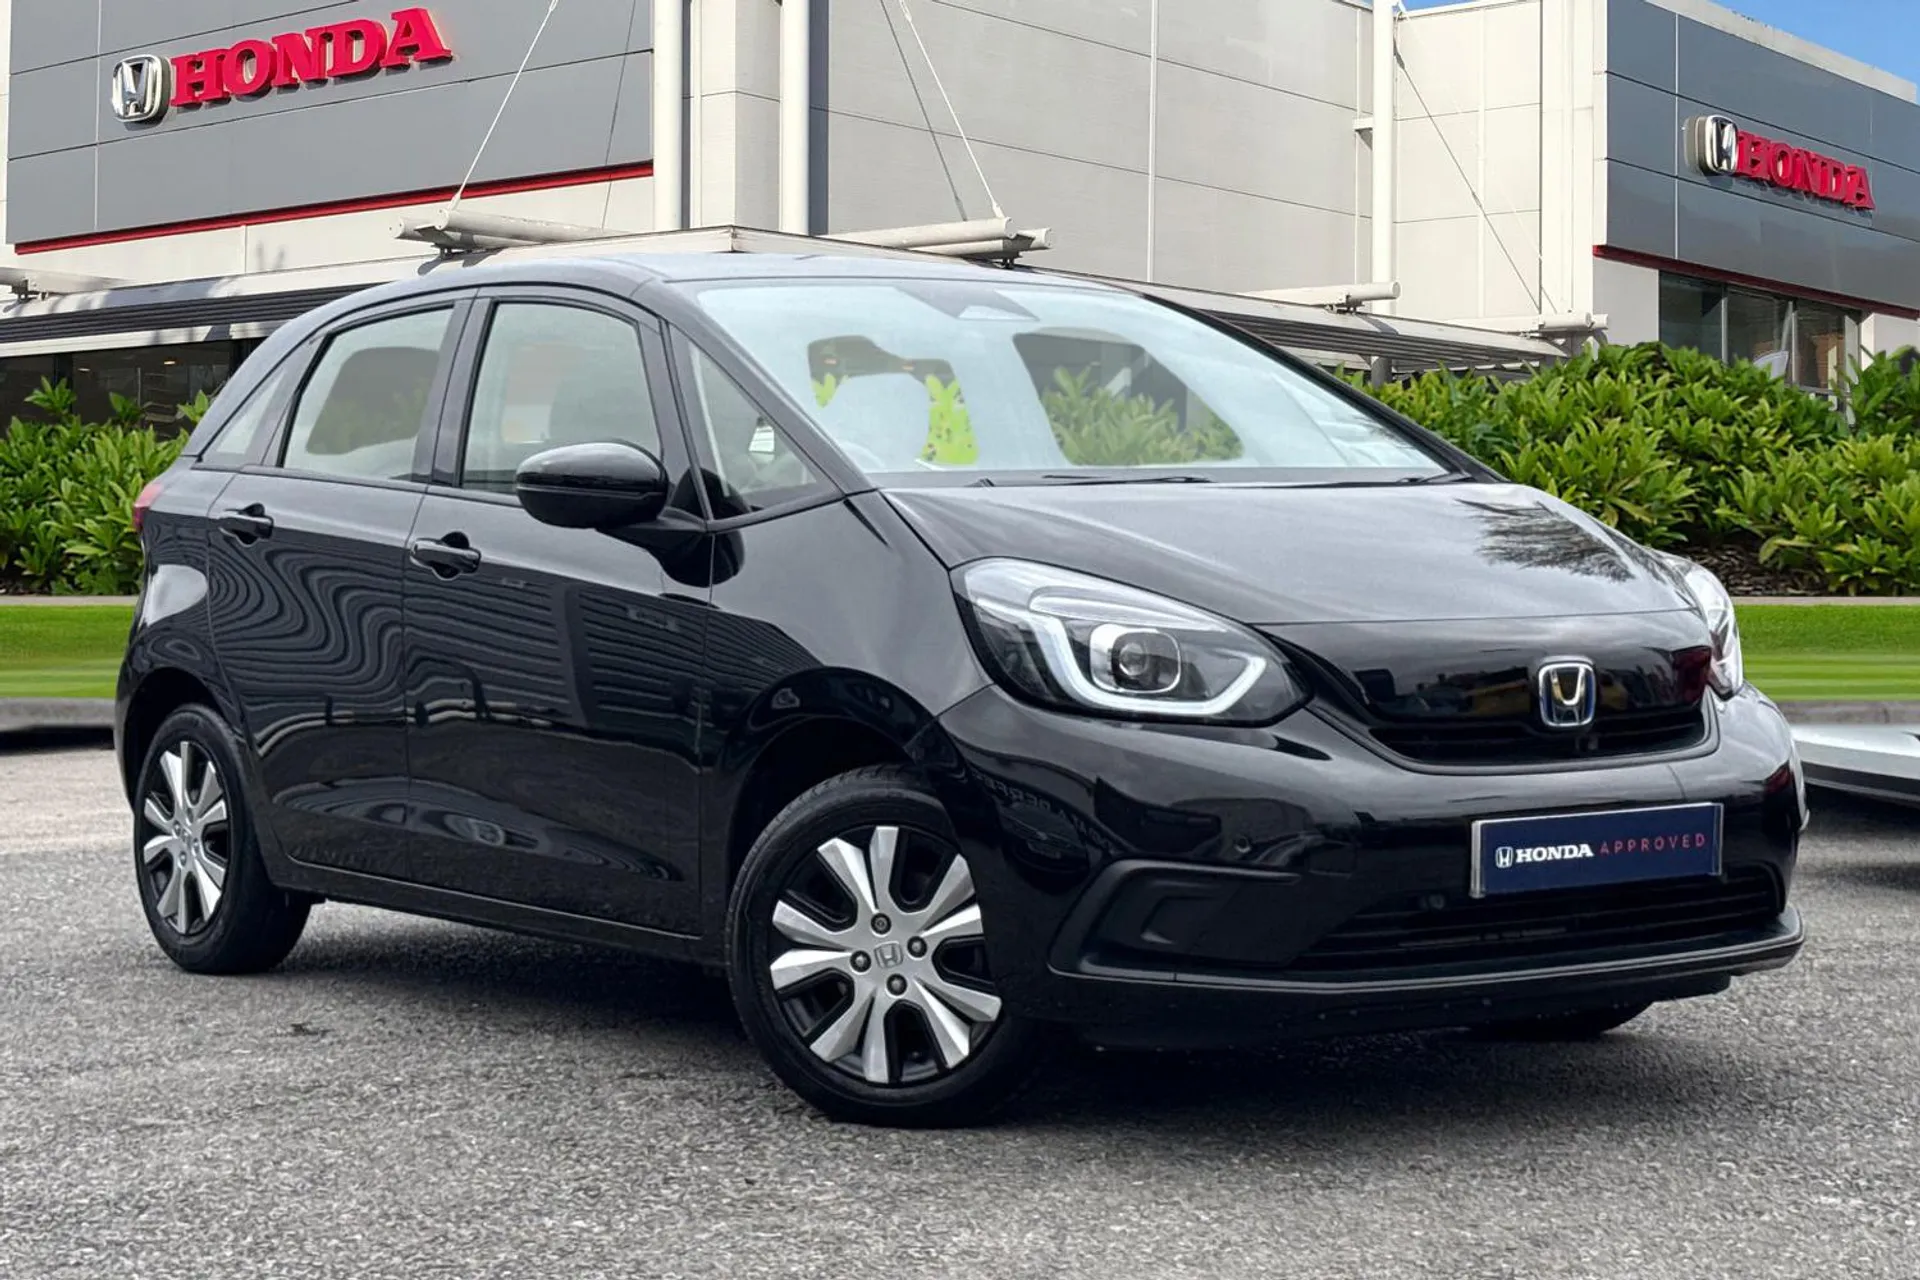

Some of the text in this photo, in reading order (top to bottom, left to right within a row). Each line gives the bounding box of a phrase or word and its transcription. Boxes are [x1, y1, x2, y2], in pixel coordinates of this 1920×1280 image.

[170, 8, 452, 107] HONDA
[1736, 130, 1875, 210] HONDA
[1516, 832, 1705, 864] HONDA APPROVED
